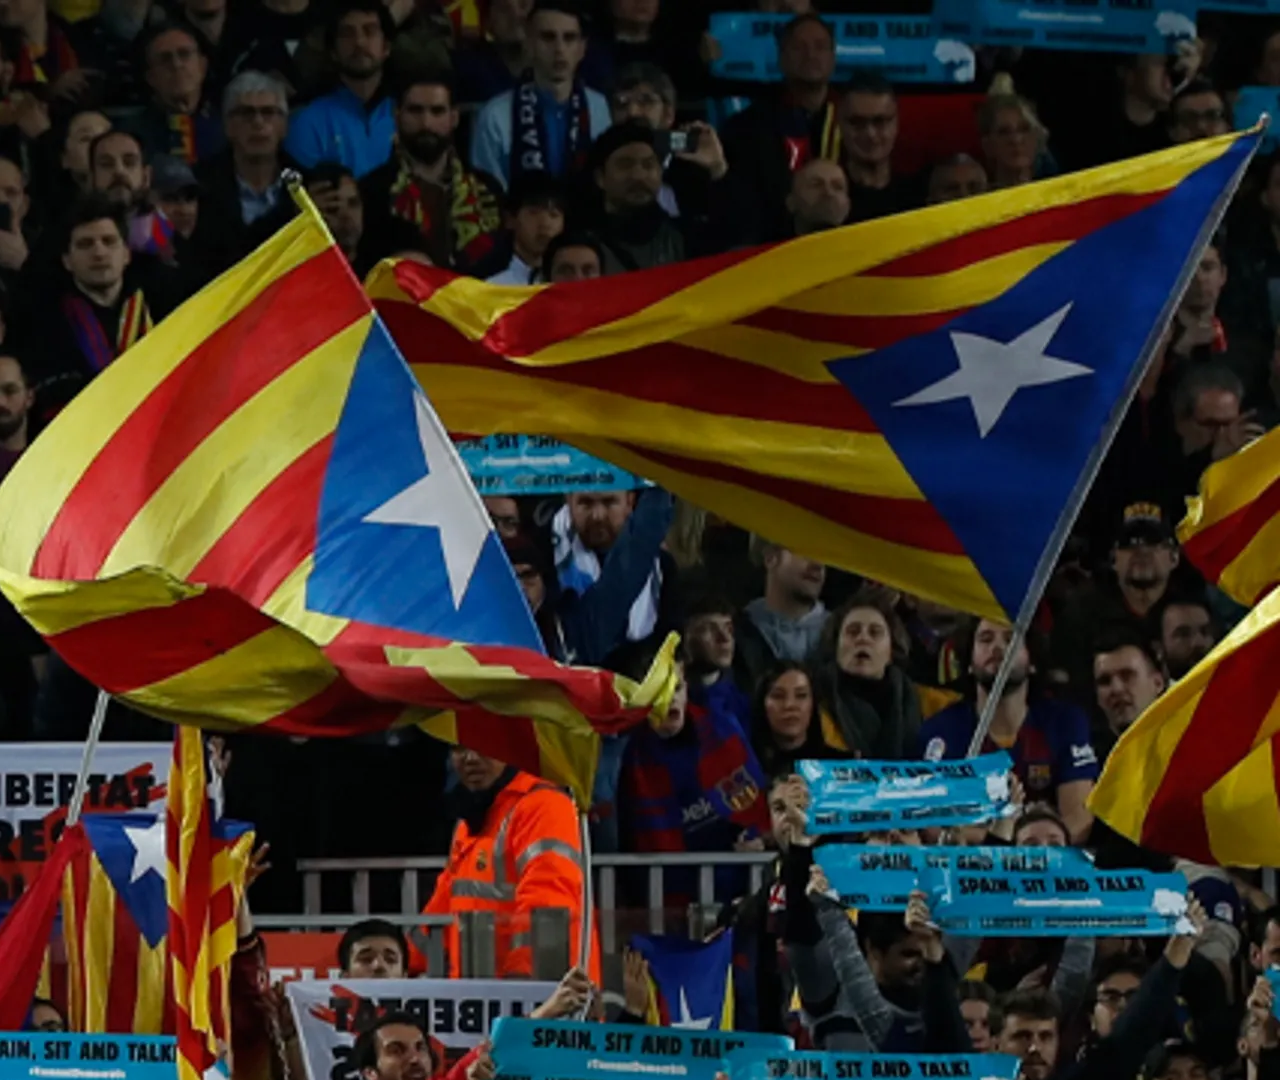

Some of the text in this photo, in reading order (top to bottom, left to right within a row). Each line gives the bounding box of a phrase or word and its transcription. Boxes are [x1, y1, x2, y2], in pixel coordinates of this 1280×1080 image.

[958, 874, 1145, 897] SPAIN, SIT AND TALK!
[44, 1039, 72, 1061] SIT
[80, 1040, 120, 1062] AND
[128, 1041, 177, 1064] TALK!
[532, 1028, 596, 1051] SPAIN,
[605, 1032, 633, 1055] SIT
[642, 1035, 682, 1057] AND
[836, 1059, 864, 1080] SIT
[871, 1060, 912, 1080] AND
[918, 1059, 973, 1079] TALK!
